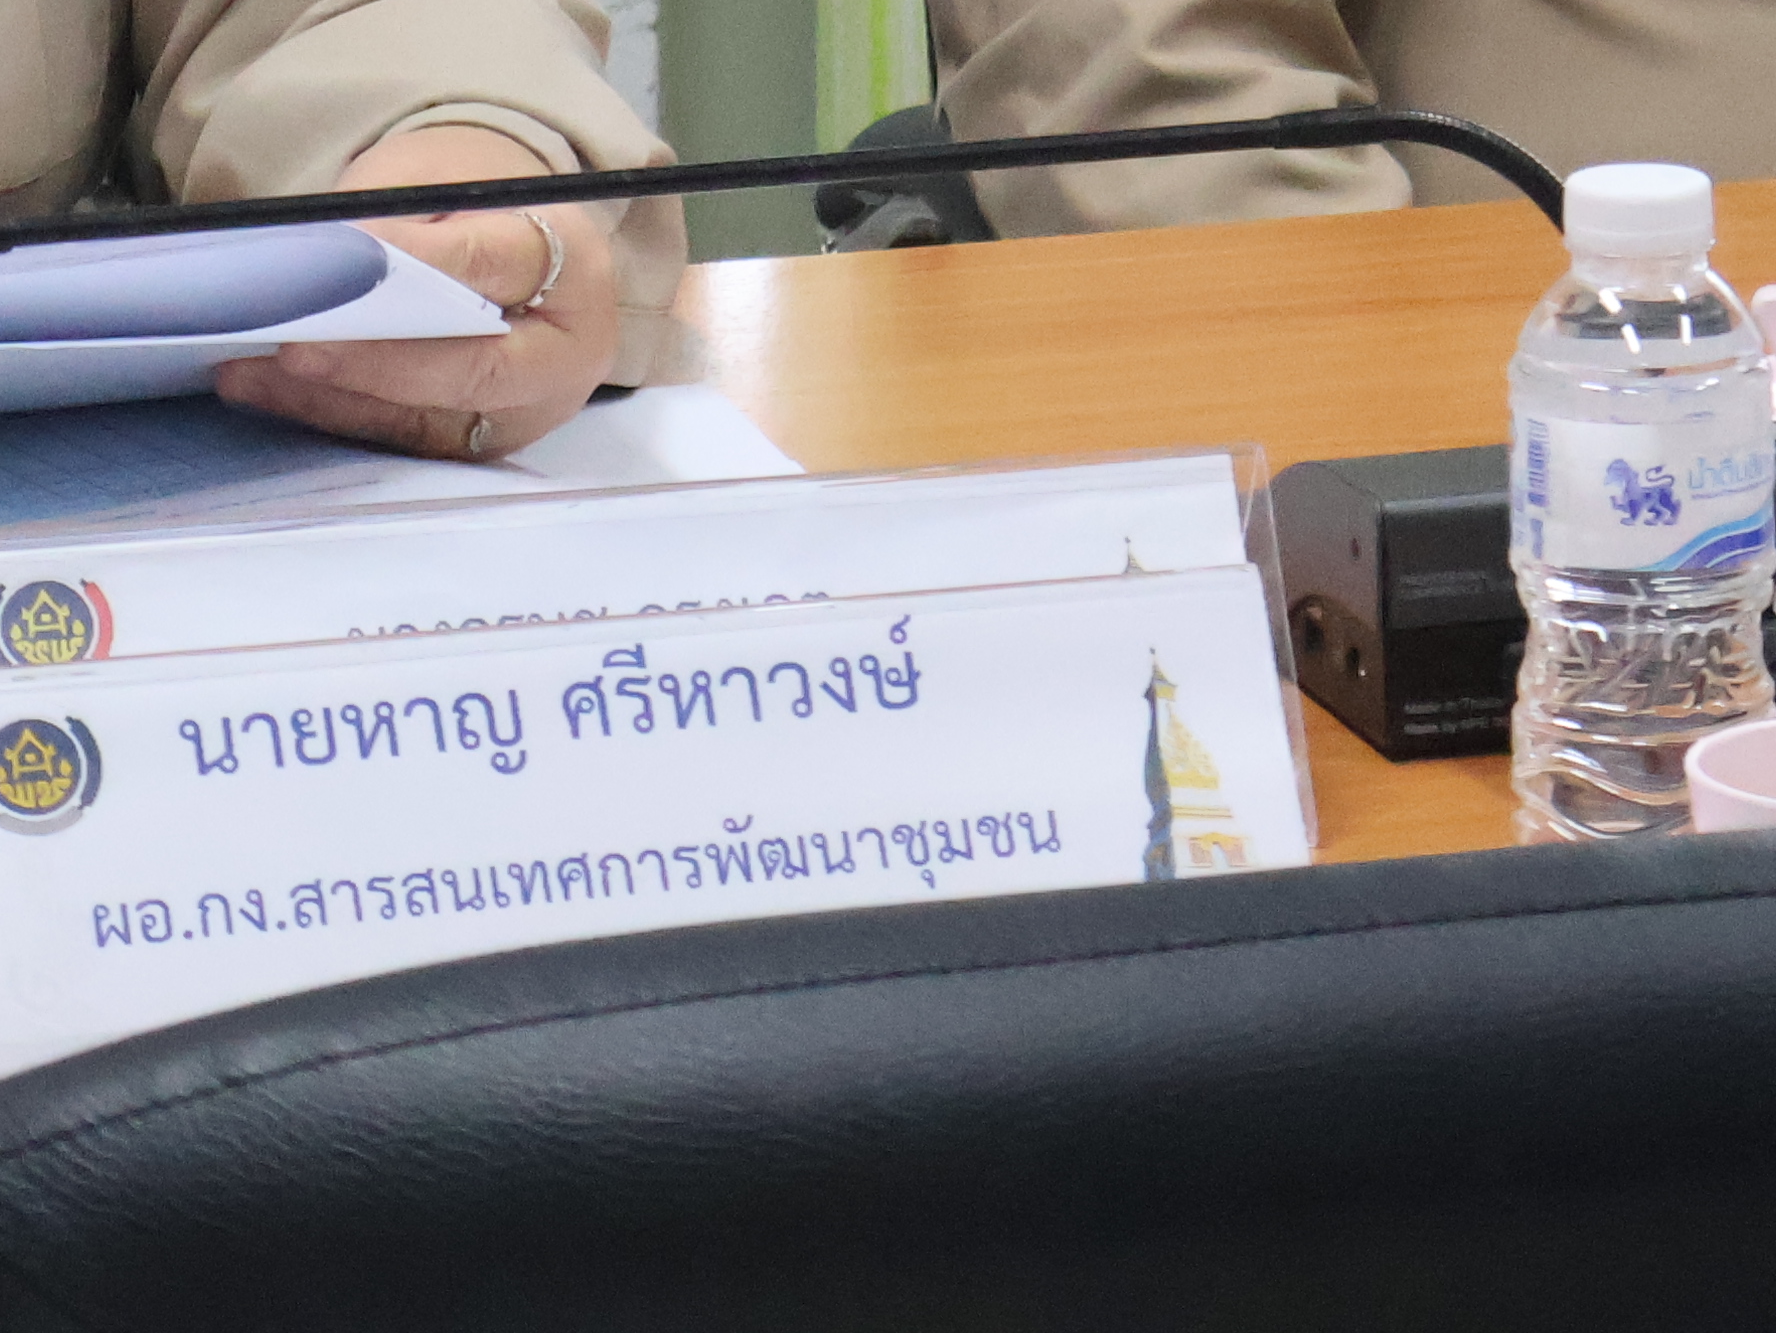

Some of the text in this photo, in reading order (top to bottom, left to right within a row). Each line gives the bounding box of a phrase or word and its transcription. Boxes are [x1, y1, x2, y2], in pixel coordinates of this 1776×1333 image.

[178, 687, 526, 779] นายหาญ
[561, 614, 922, 740] ศรีหาวงษ์
[91, 805, 1062, 948] ผอ.กง.สารสนเทศการพัฒนาชุมชน
